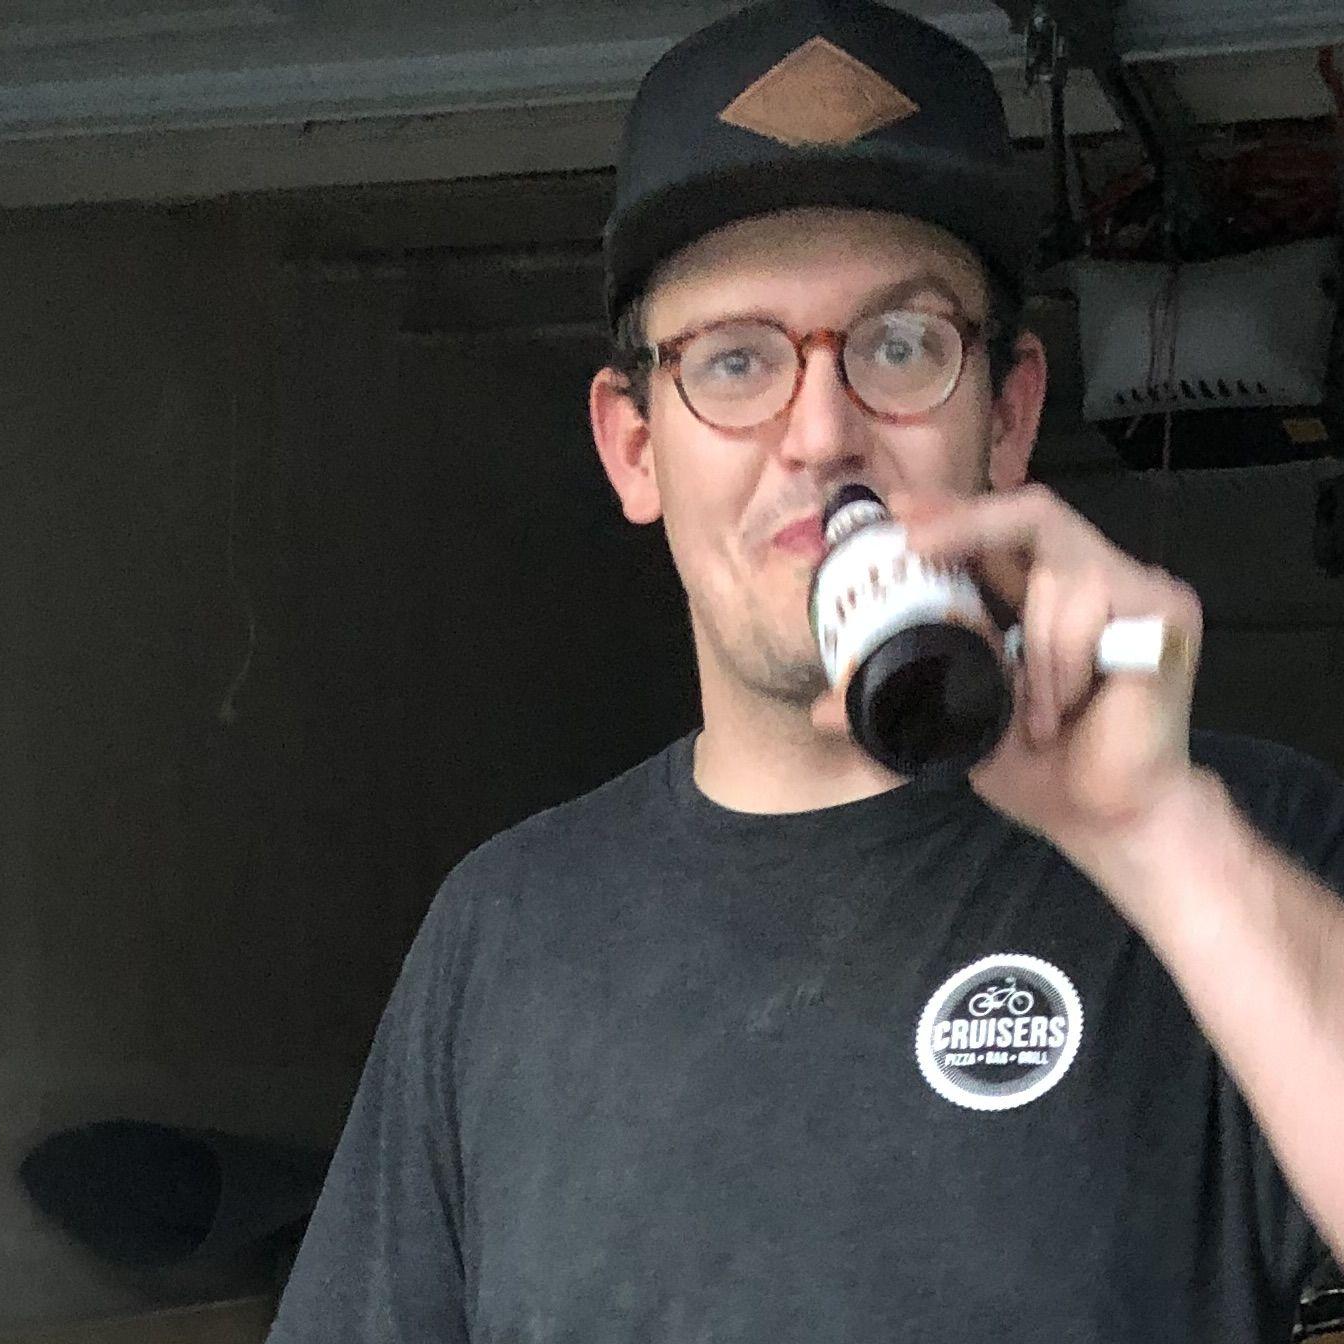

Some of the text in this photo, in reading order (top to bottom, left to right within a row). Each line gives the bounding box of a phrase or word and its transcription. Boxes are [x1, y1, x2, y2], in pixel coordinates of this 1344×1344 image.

[932, 1016, 1066, 1051] CRUISERS
[945, 1051, 976, 1067] PIZZA
[985, 1051, 1009, 1065] BAR
